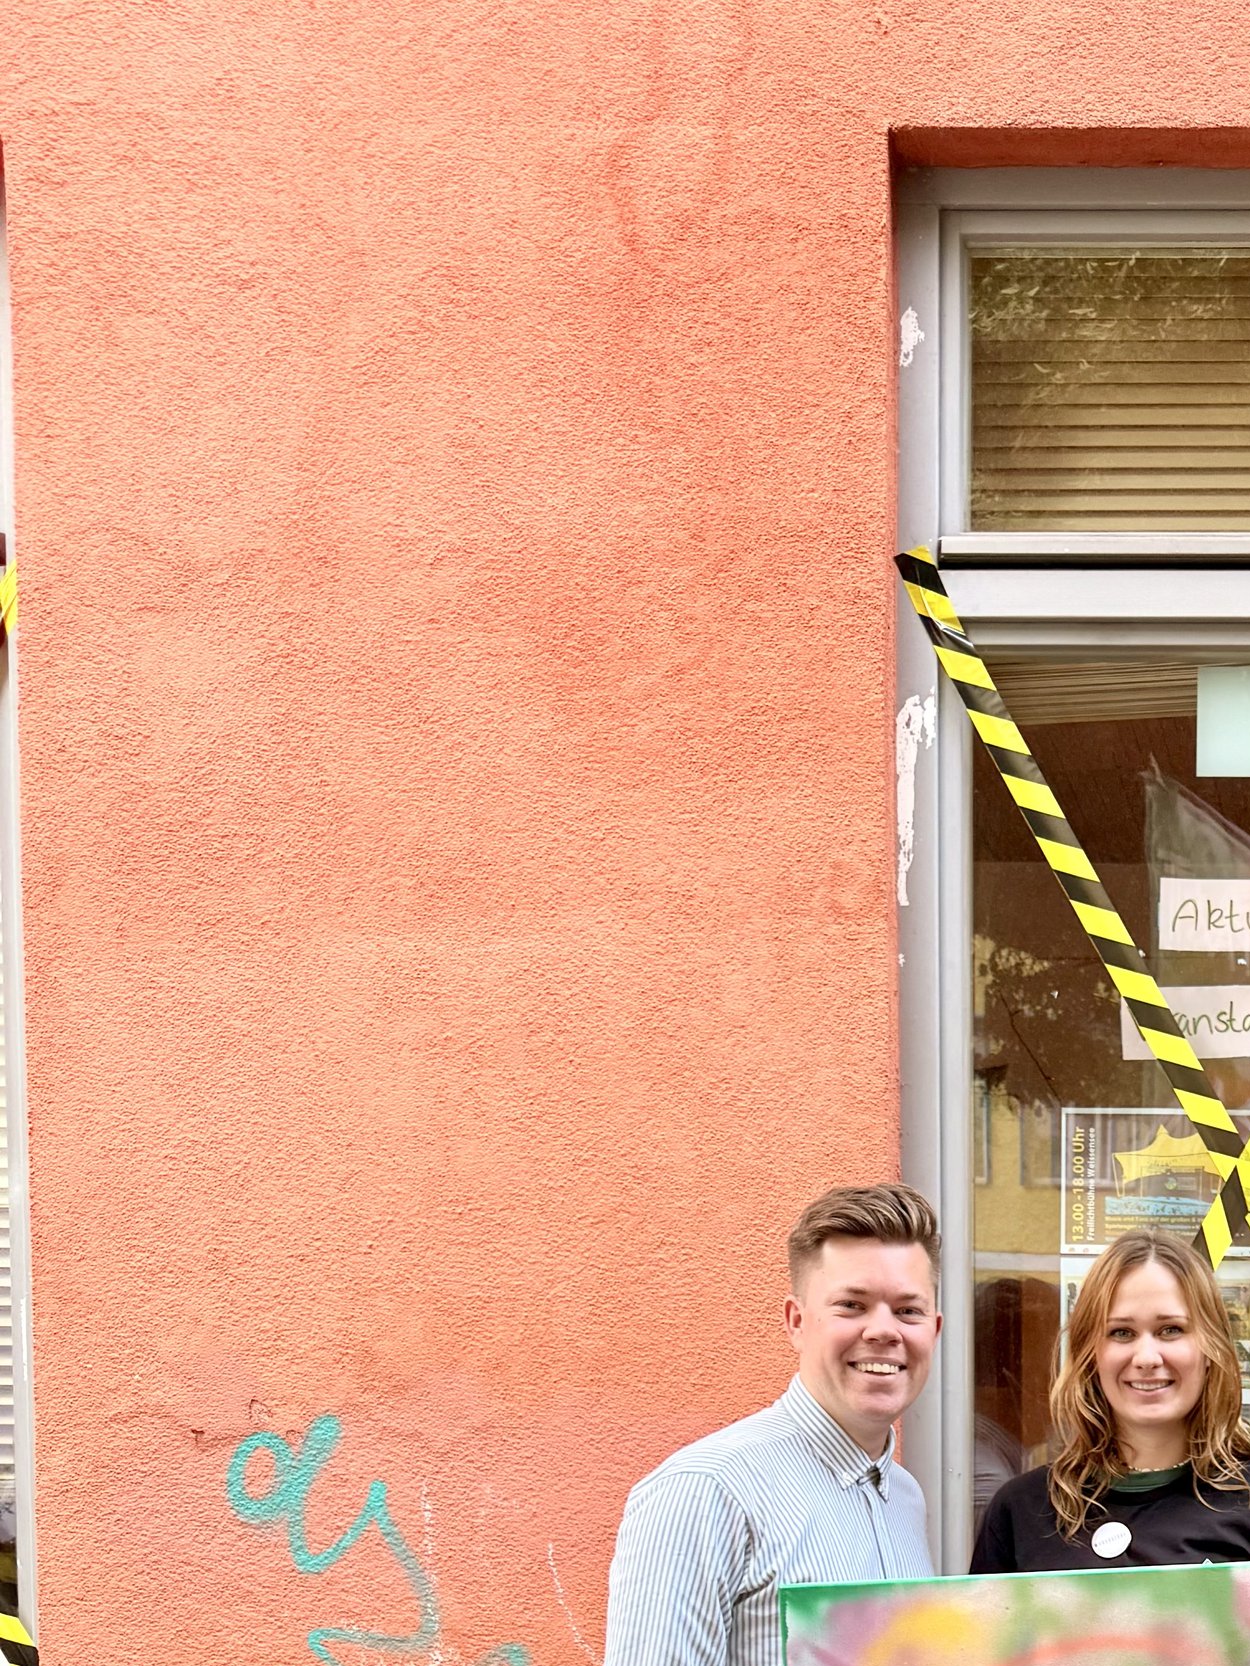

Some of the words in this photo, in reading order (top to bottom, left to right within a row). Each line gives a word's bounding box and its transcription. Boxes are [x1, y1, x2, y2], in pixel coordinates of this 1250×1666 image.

[1071, 1126, 1085, 1153] Uhr
[1086, 1127, 1096, 1178] Weissensee
[1071, 1204, 1084, 1242] 13.00
[1086, 1178, 1096, 1241] Freilichtbühne
